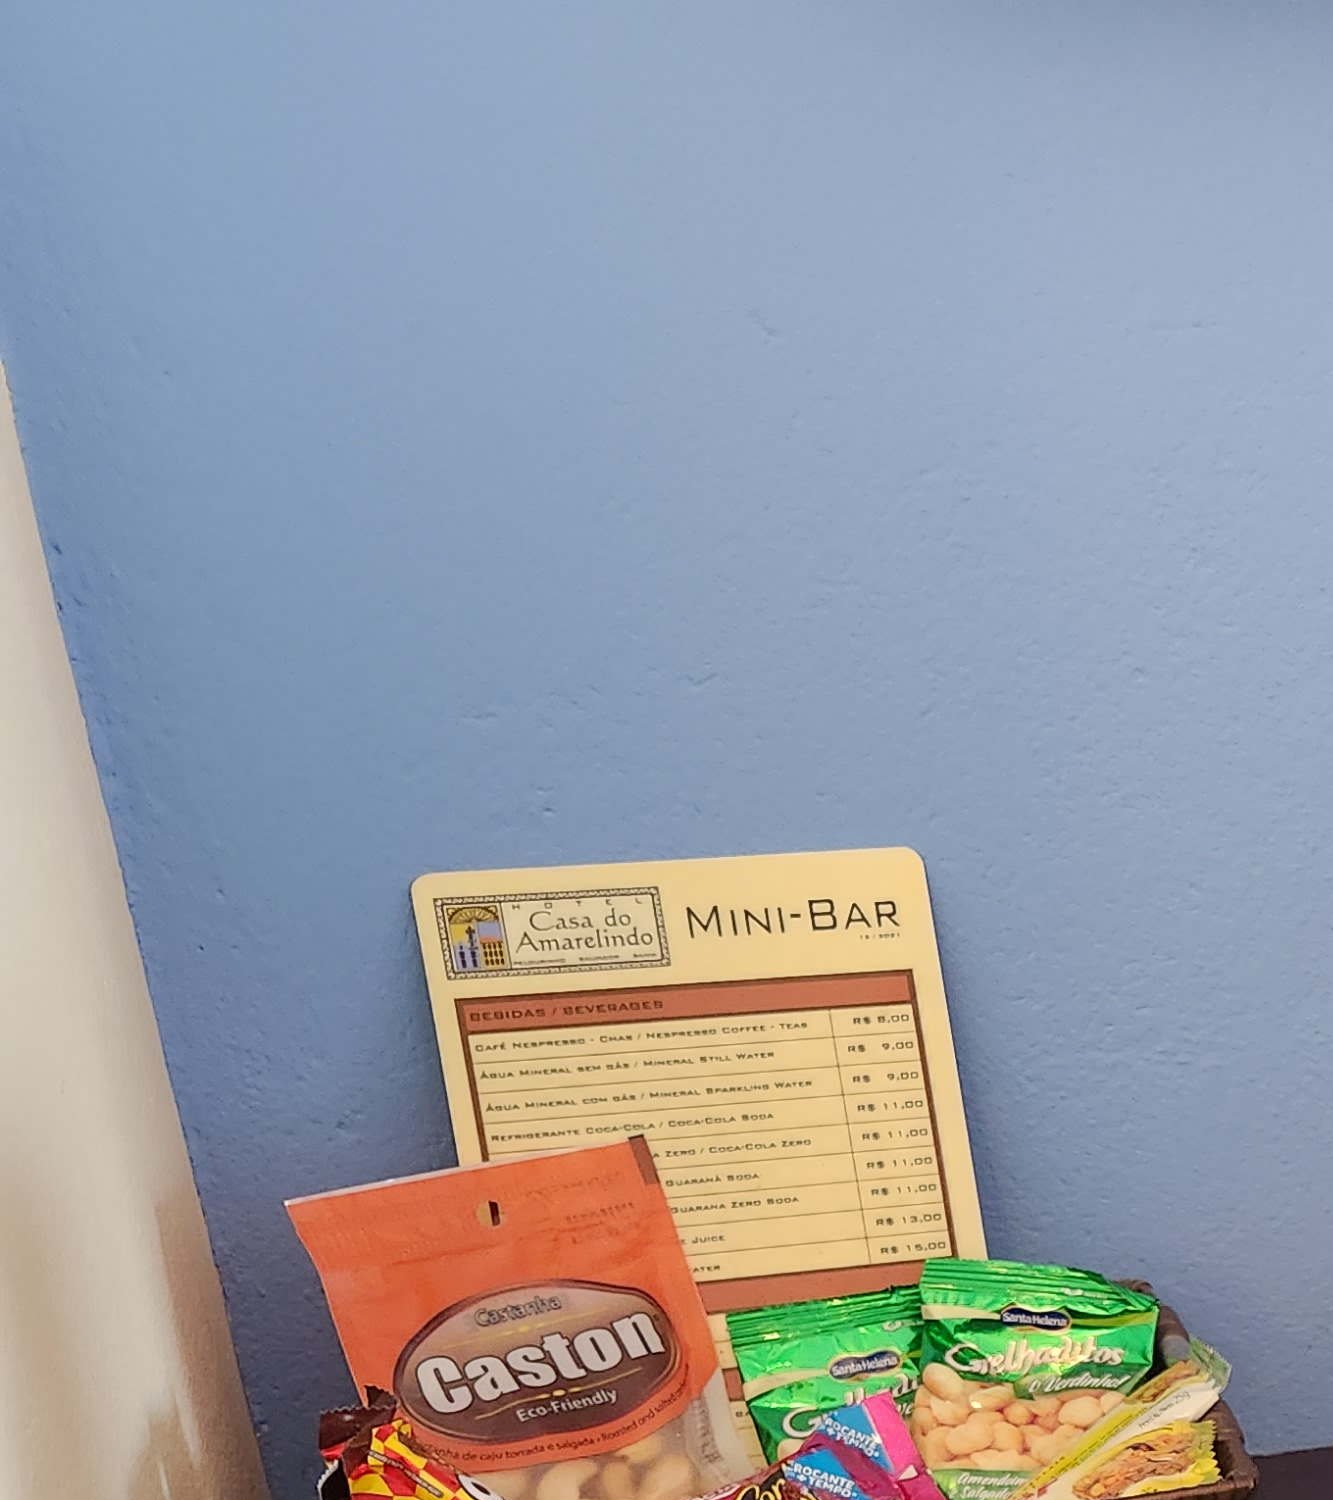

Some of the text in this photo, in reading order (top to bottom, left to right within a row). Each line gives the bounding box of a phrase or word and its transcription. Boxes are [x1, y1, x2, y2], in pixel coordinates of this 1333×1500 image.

[528, 906, 631, 931] Casa do
[685, 899, 901, 939] MINI-BAR
[515, 925, 653, 953] Amarelindo
[847, 1040, 914, 1052] R$ 9,00
[880, 1241, 946, 1254] R$ 15,00
[473, 1294, 563, 1328] Castanha
[415, 1311, 667, 1414] Caston
[515, 1388, 618, 1423] Eco-Friendly
